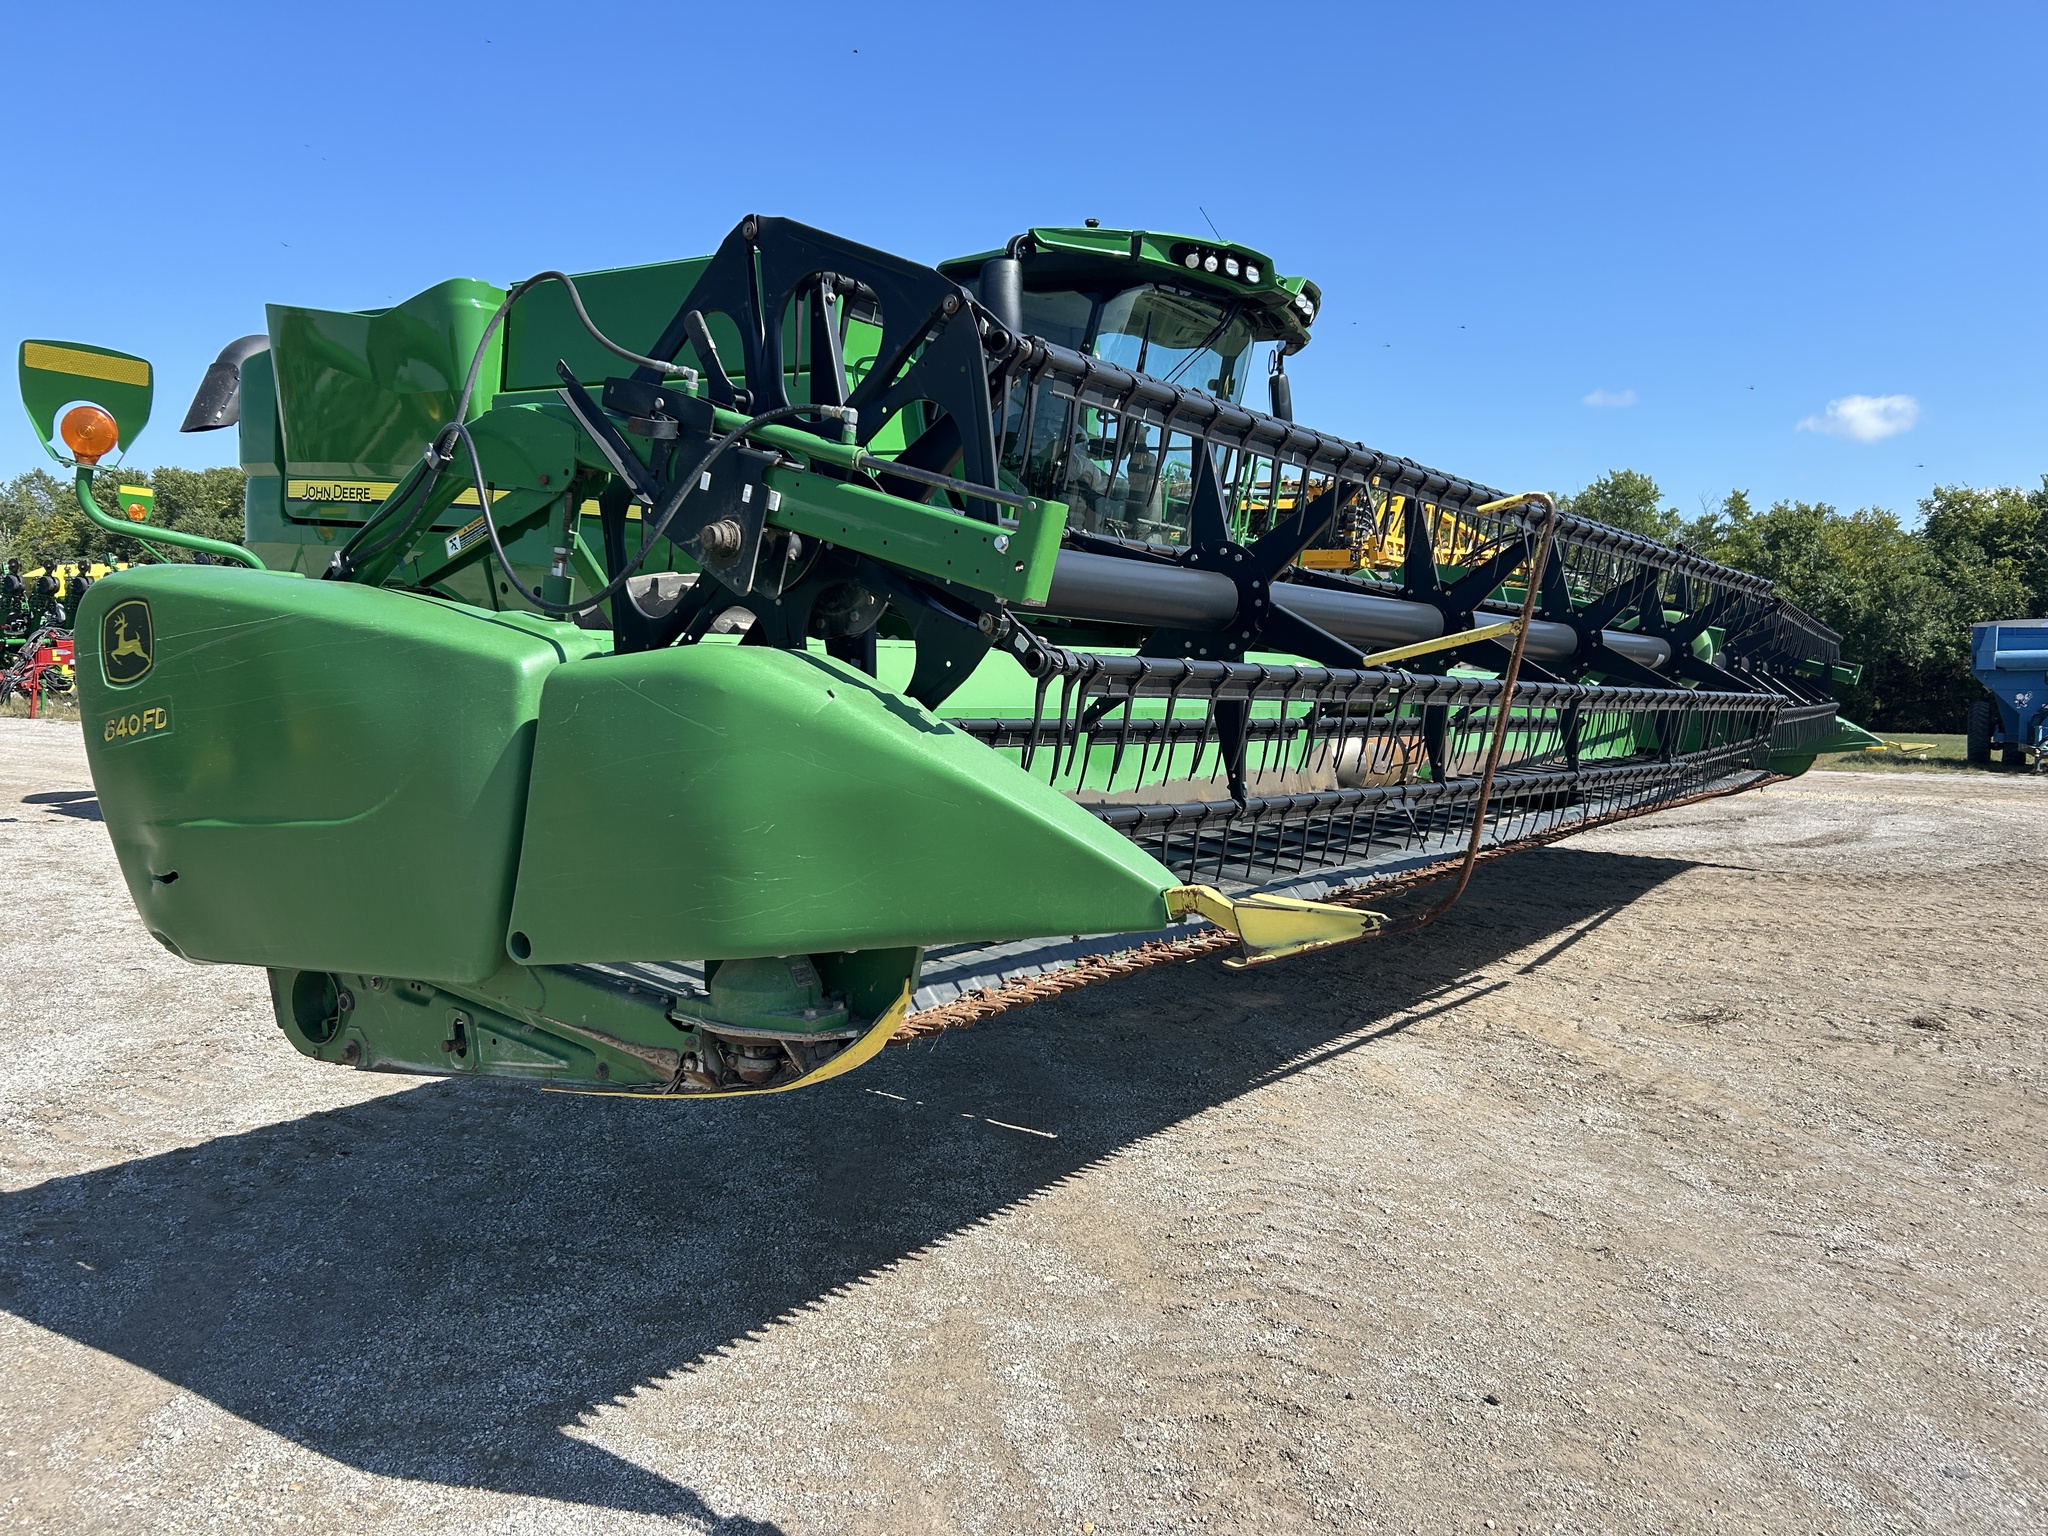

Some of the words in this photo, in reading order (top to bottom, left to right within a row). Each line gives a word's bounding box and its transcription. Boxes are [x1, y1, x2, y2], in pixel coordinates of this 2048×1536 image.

[302, 483, 331, 499] JOHN
[333, 484, 371, 500] DEERE
[103, 707, 167, 742] 640FD
